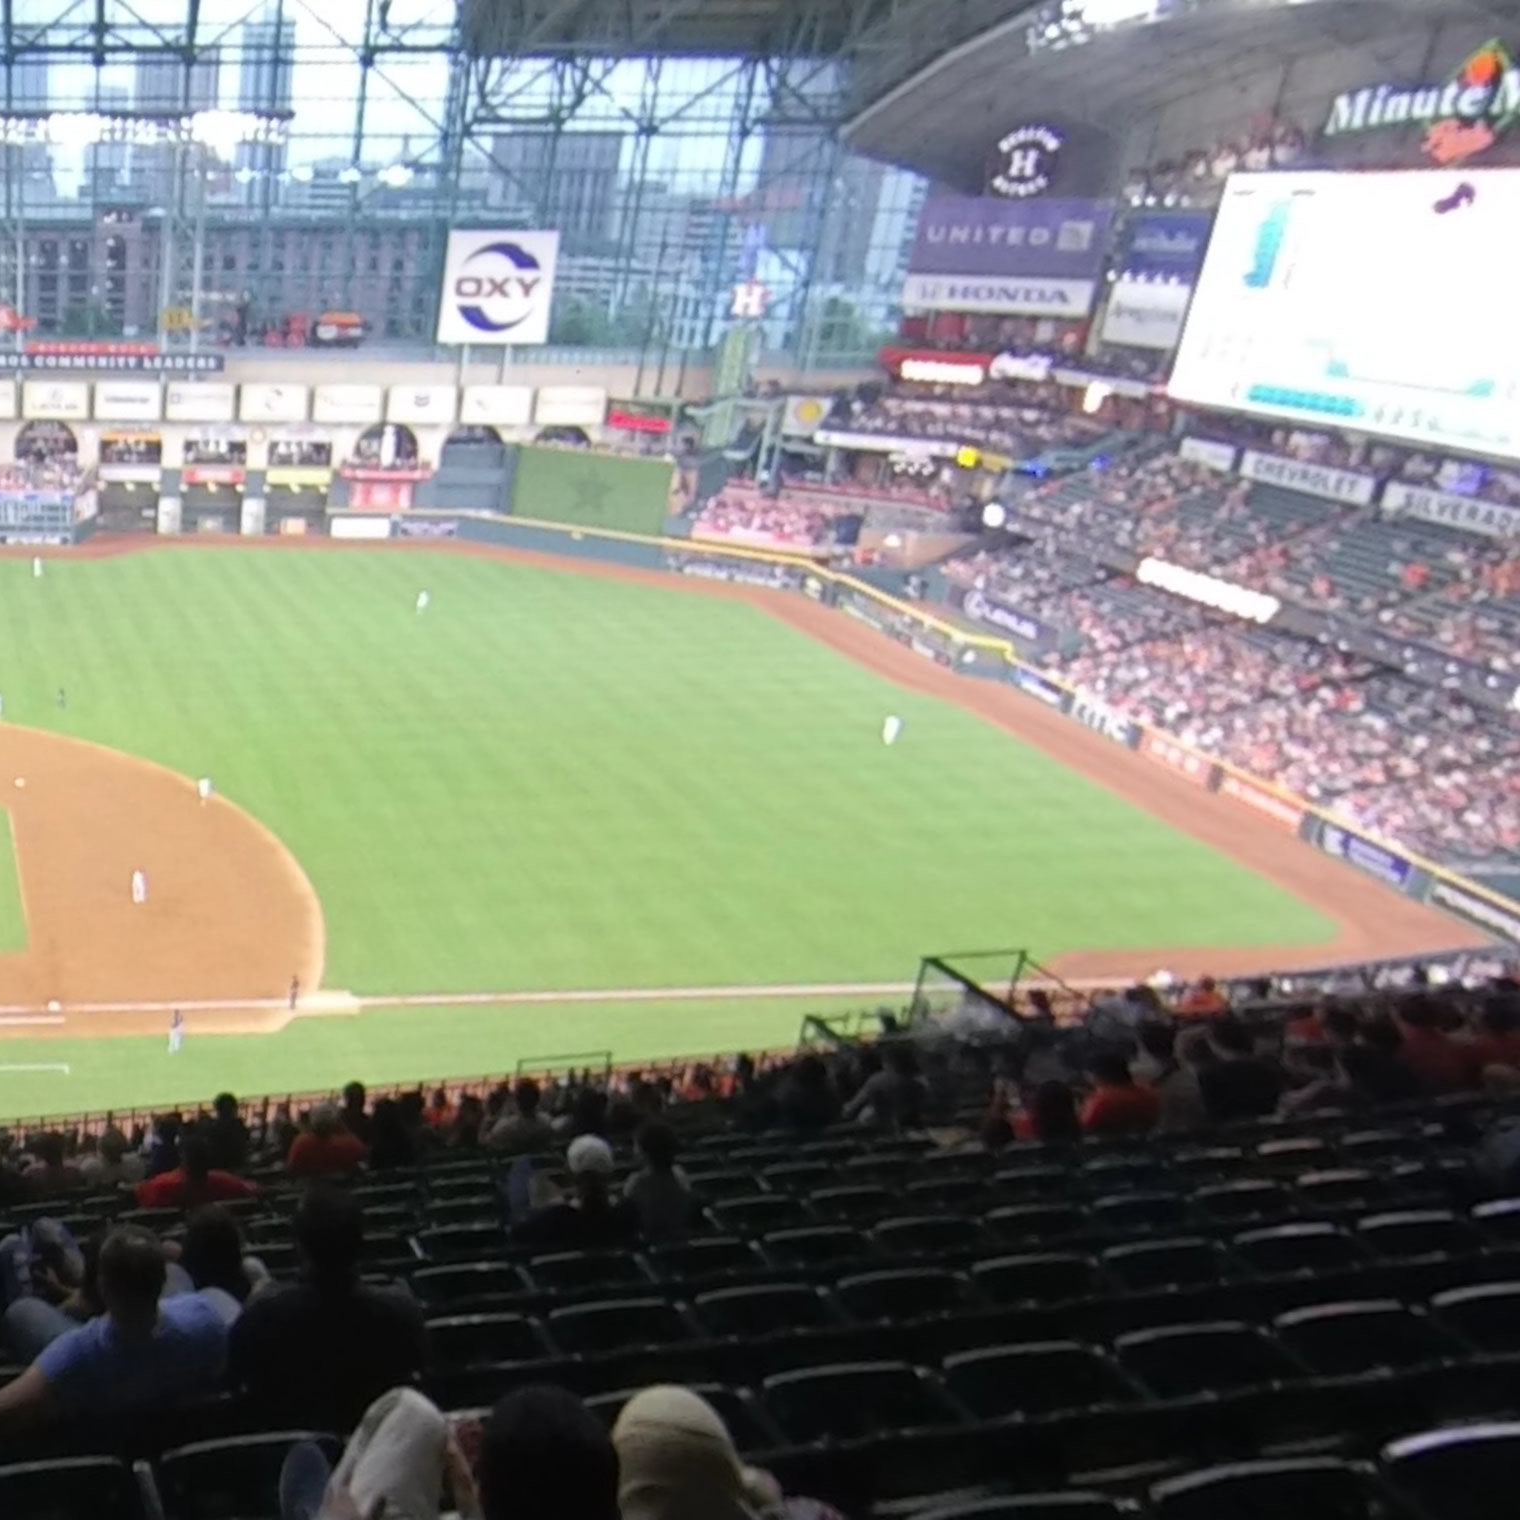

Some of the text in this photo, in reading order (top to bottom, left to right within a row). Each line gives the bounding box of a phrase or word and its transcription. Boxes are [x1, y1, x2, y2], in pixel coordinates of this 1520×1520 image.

[1324, 79, 1491, 136] Minute
[927, 225, 1050, 246] UNITED
[455, 276, 541, 298] OXY
[947, 285, 1070, 304] HONDA
[33, 354, 138, 369] COMMUNITY
[142, 355, 217, 370] LEADERS
[1252, 458, 1360, 497] CHEVROLET
